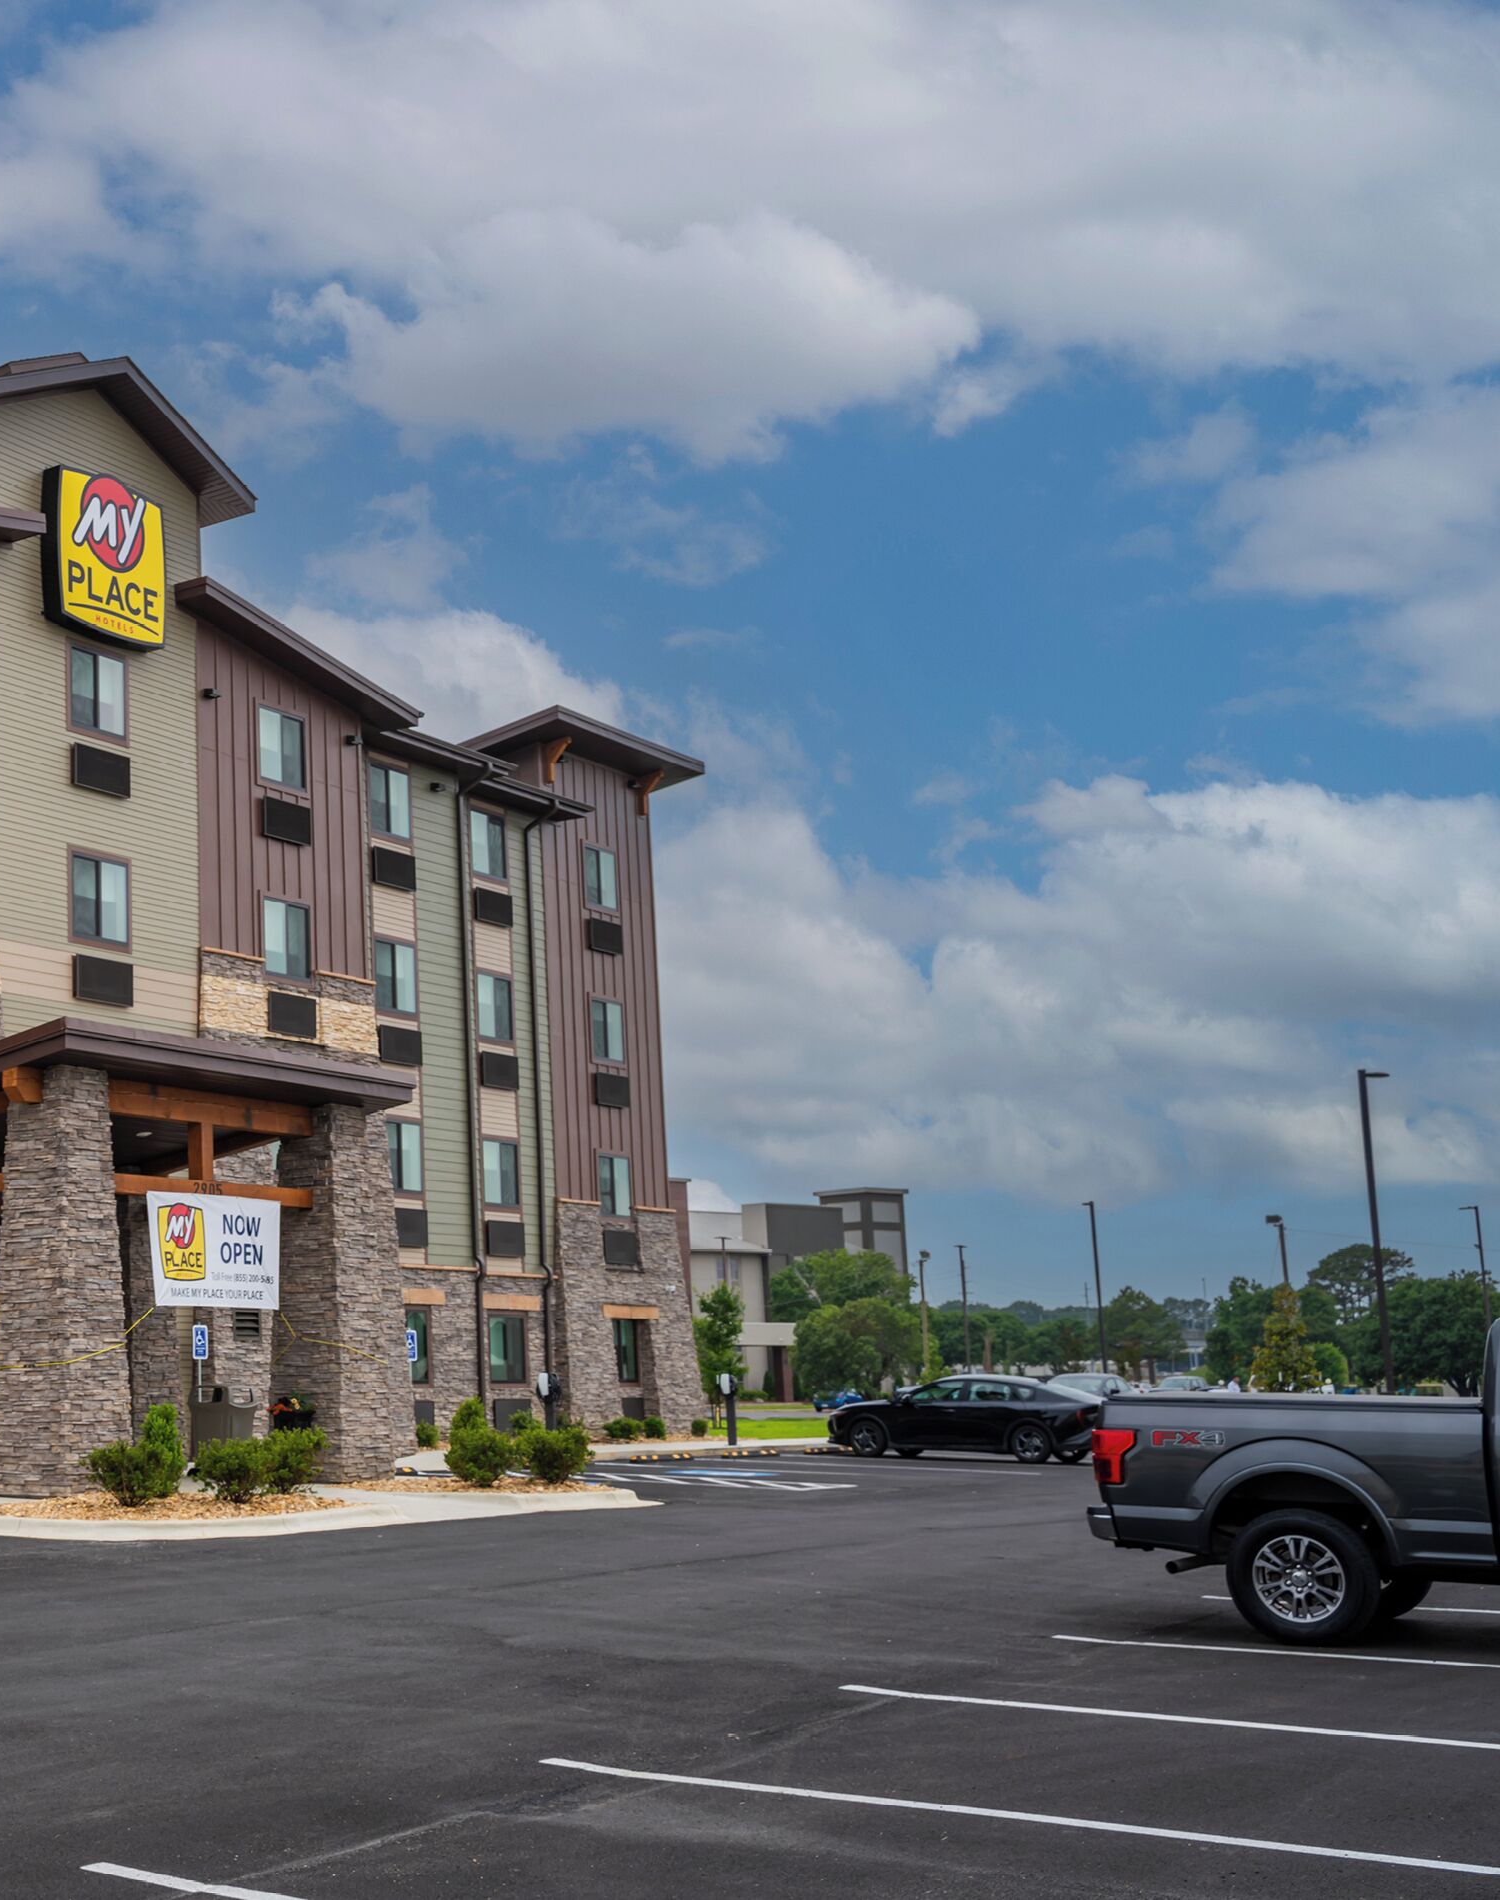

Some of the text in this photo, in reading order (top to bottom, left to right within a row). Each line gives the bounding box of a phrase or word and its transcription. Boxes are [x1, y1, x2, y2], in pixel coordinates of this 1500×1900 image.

[68, 559, 159, 623] PLACE
[95, 614, 135, 634] HOTELS
[193, 1182, 223, 1195] 2905
[222, 1214, 261, 1237] NOW
[164, 1251, 203, 1268] PLACE
[220, 1242, 263, 1266] OPEN
[170, 1287, 264, 1300] MAKE MY PLACE YOUR PLACE
[1151, 1429, 1226, 1447] FX4
